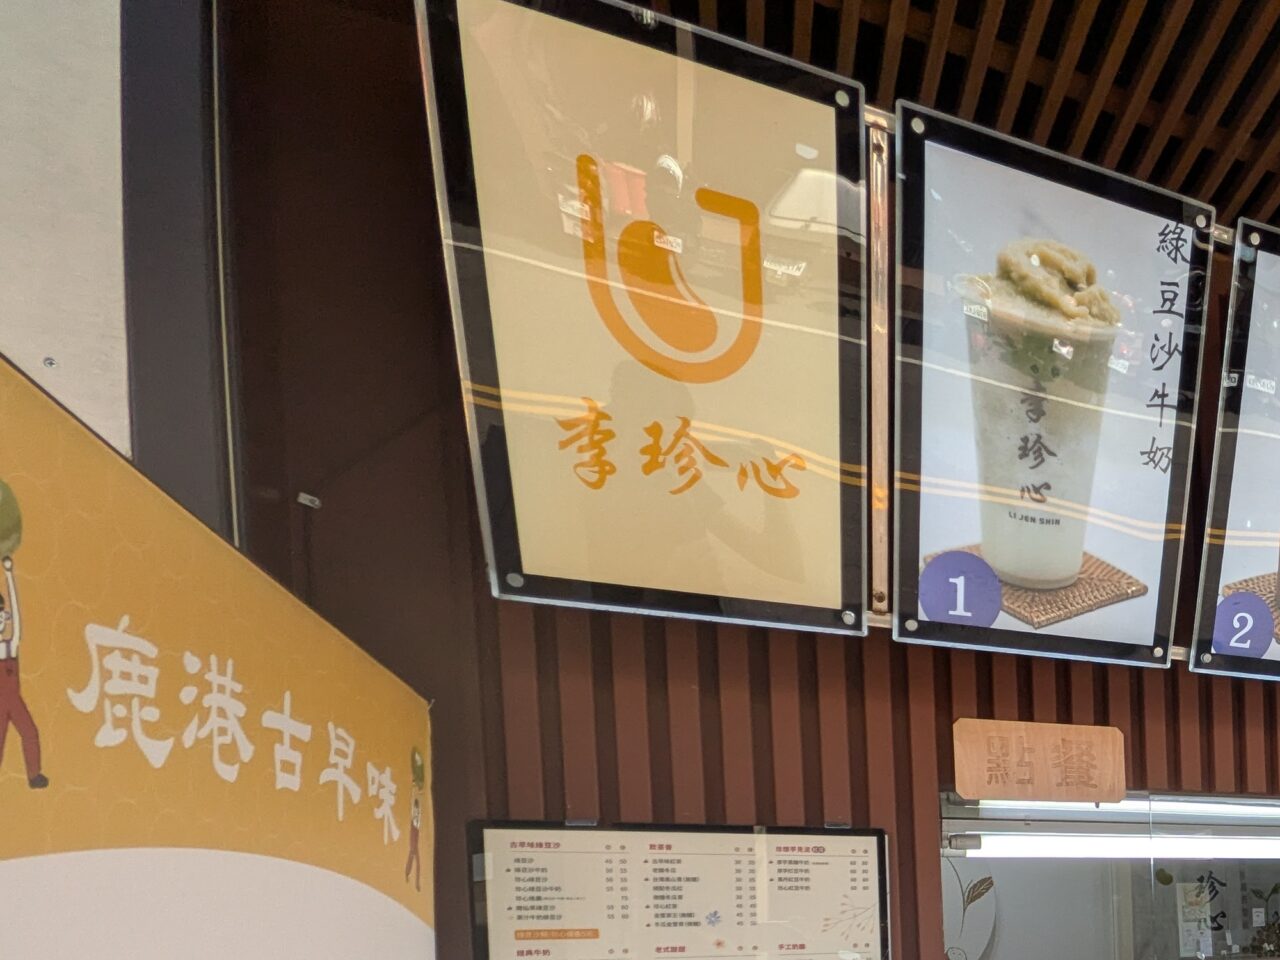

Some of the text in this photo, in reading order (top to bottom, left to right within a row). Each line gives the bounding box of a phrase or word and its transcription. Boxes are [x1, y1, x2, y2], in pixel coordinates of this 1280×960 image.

[1139, 220, 1192, 474] 綠豆沙牛奶
[556, 396, 807, 500] 李珍心
[1017, 380, 1057, 504] 李珍心
[948, 575, 973, 617] 1
[1229, 612, 1255, 649] 2
[66, 614, 400, 845] 鹿港古早味
[986, 735, 1099, 789] 點餐
